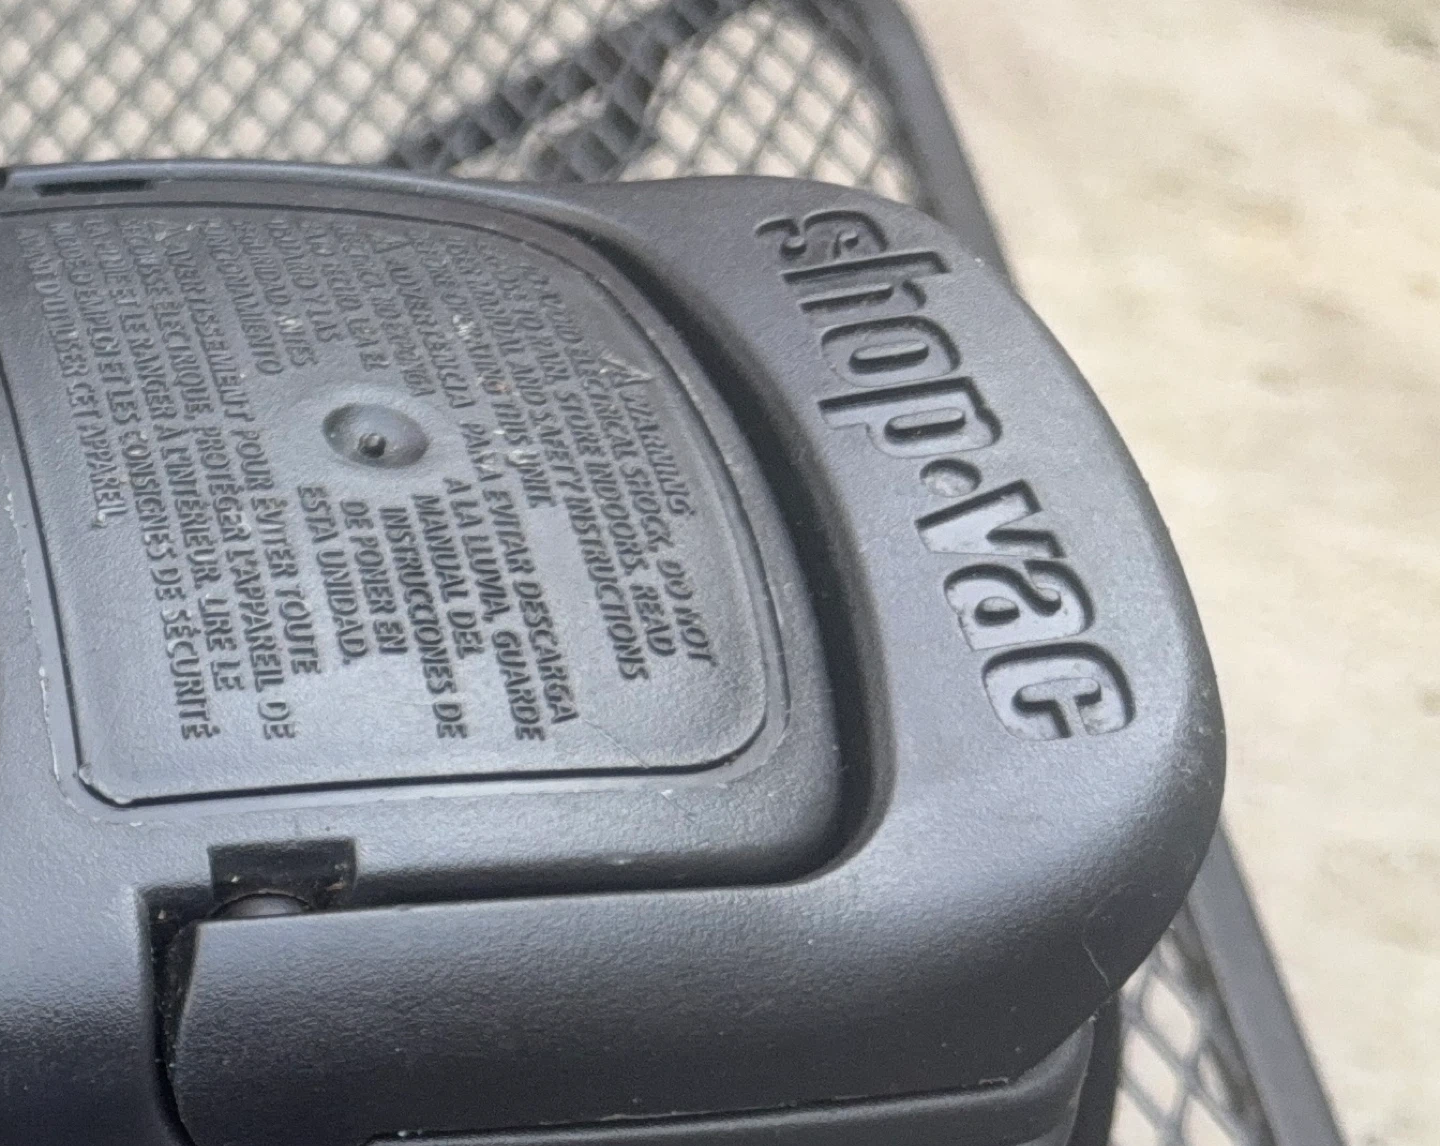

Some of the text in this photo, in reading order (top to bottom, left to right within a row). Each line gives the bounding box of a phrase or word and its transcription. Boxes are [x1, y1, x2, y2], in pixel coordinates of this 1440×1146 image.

[117, 311, 150, 333] LE
[64, 382, 102, 419] CET
[98, 362, 131, 385] ET
[127, 337, 178, 420] RANGER
[503, 358, 550, 406] AND
[106, 389, 142, 425] LES
[154, 425, 190, 441] À
[489, 401, 534, 446] THIS
[229, 430, 275, 490] POUR
[525, 409, 587, 494] SAFETY
[116, 430, 176, 560] CONSIGNES
[296, 485, 341, 543] ESTA
[441, 477, 474, 494] A
[448, 499, 486, 528] LA
[512, 309, 546, 331] TO
[551, 389, 605, 456] STORE
[583, 461, 650, 575] INDOORS.
[628, 582, 678, 657] READ
[620, 467, 675, 553] SHOCK,
[248, 496, 300, 578] ÉVITER
[338, 499, 375, 530] DE
[149, 566, 186, 601] DE
[191, 424, 252, 542] PROTÉGER
[257, 700, 297, 740] DE
[348, 534, 398, 614] PONER
[409, 493, 471, 603] MANUAL
[445, 607, 486, 659] DEL
[459, 534, 515, 623] LLUVIA,
[561, 496, 653, 682] INSTRUCTIONS
[655, 558, 695, 601] DO
[197, 596, 236, 652] LIRE
[272, 585, 322, 676] TOUTE
[314, 549, 372, 665] UNIDAD.
[370, 619, 411, 655] EN
[377, 506, 458, 695] INSTRUCCIONES
[431, 701, 469, 741] DE
[480, 488, 537, 574] EVITAR
[511, 579, 582, 725] DESCARGA
[671, 605, 719, 667] NOT
[158, 608, 221, 741] SÉCURITÉ
[209, 659, 247, 692] LE
[488, 629, 548, 744] GUARDE
